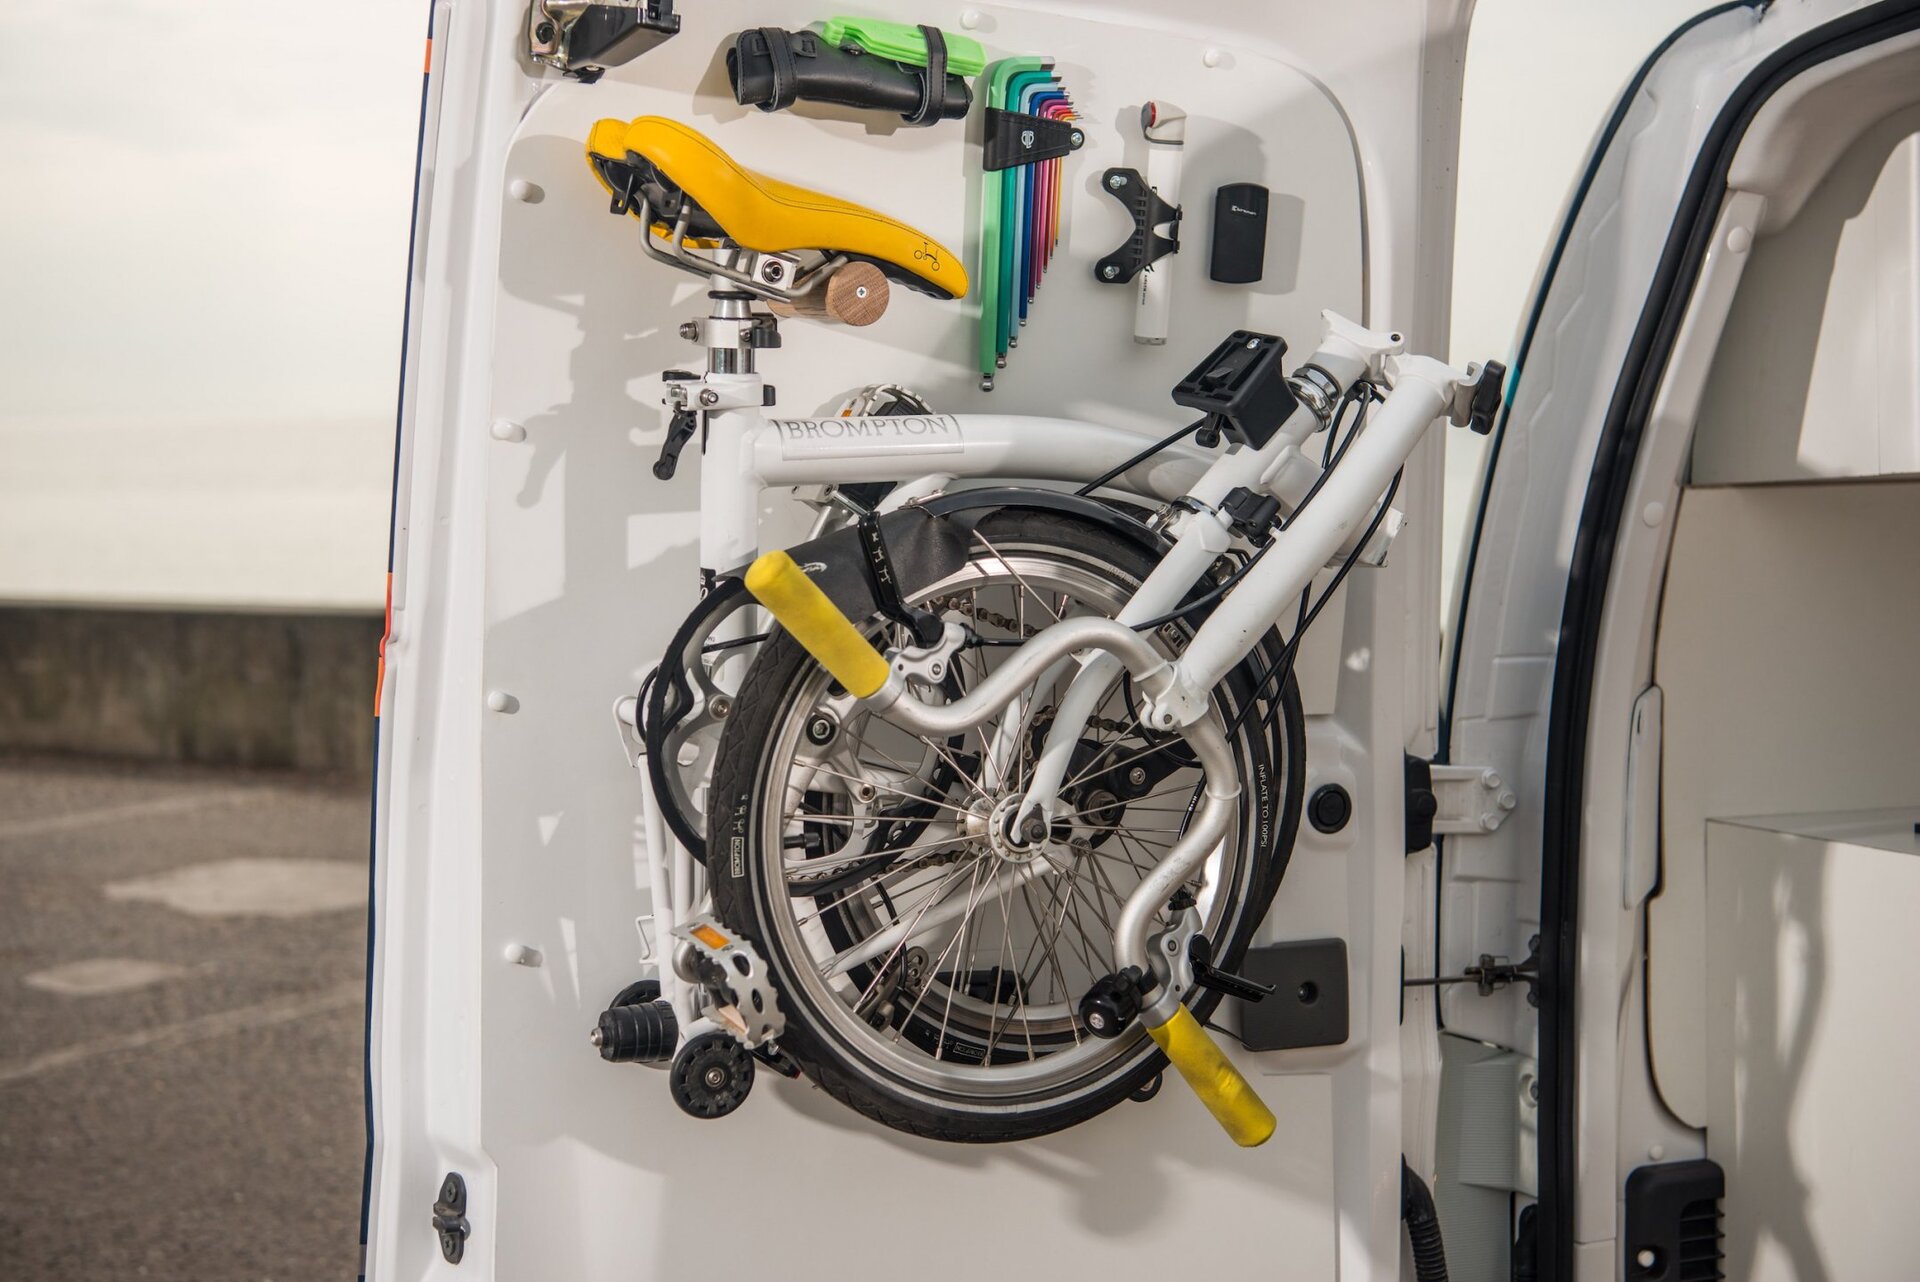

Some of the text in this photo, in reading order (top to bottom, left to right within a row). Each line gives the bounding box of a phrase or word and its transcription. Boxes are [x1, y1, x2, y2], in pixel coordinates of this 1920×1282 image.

[784, 417, 950, 440] BROMPTON
[1258, 764, 1269, 801] INFLATE
[1262, 804, 1269, 819] TO
